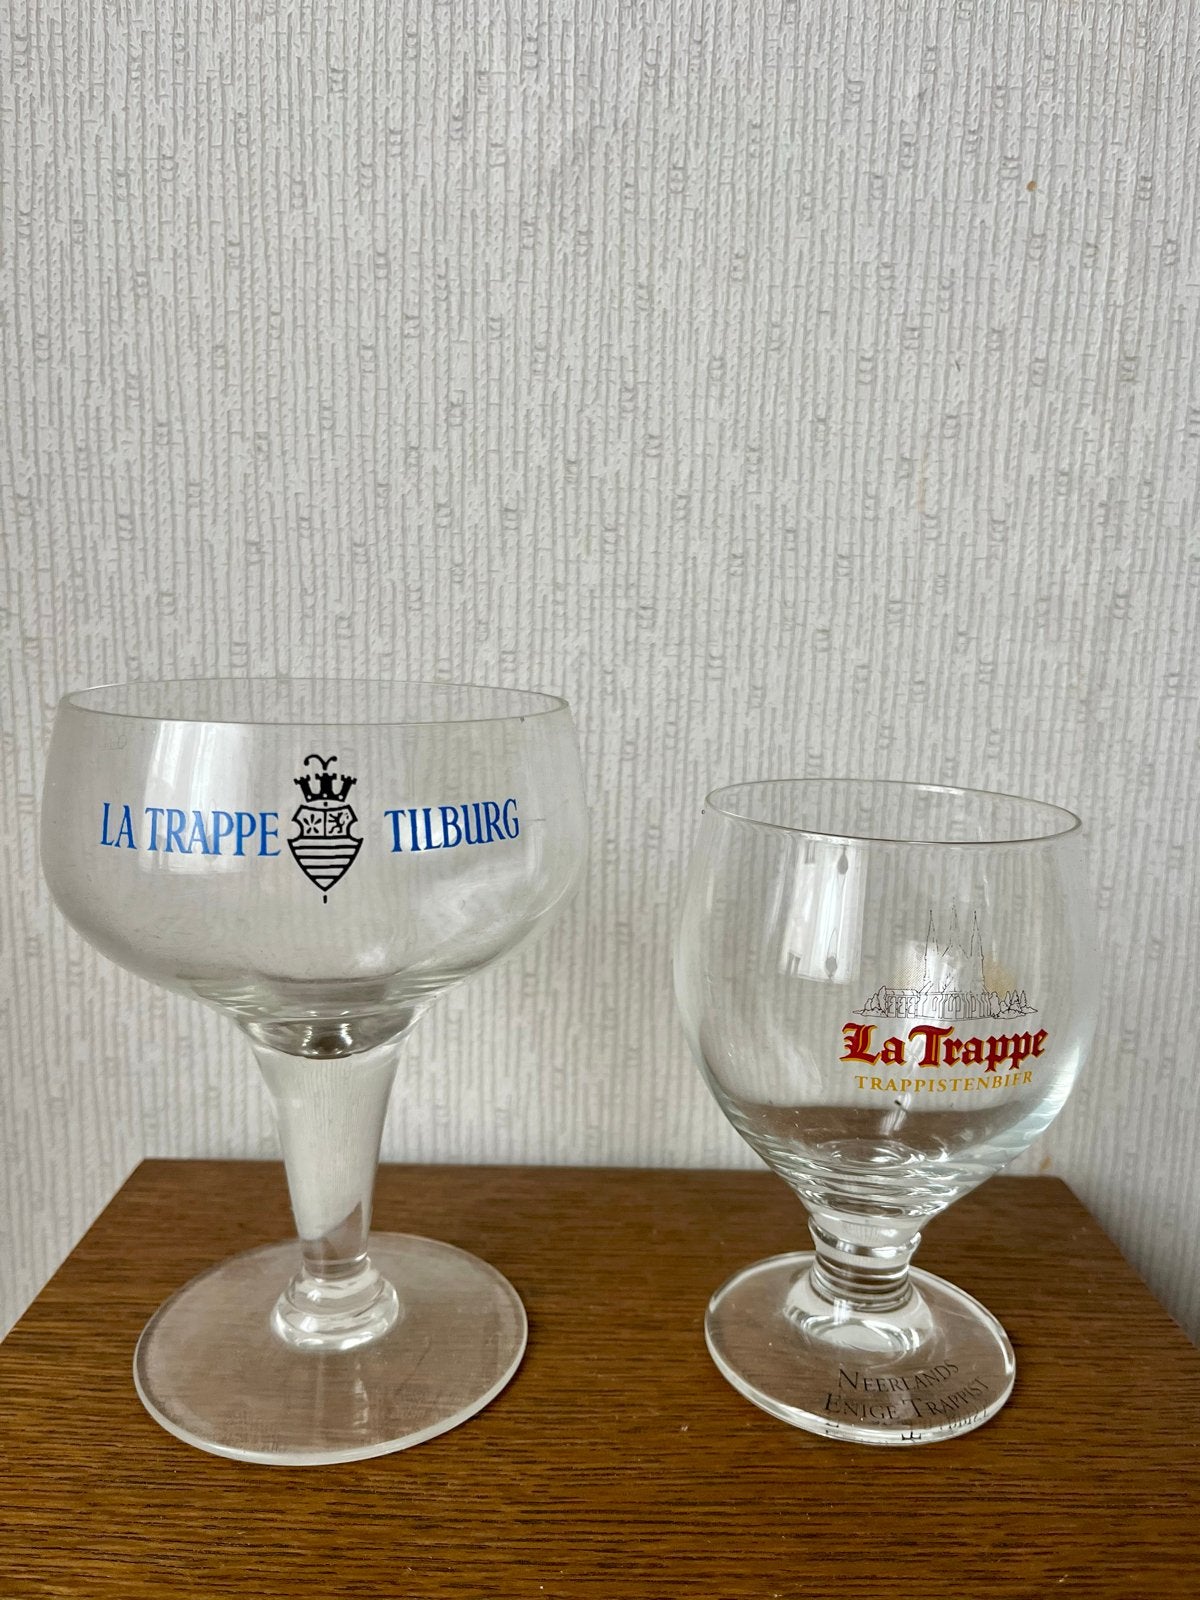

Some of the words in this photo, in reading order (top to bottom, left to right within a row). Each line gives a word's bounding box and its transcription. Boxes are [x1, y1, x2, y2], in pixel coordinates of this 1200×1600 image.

[101, 803, 138, 849] LA
[145, 807, 281, 857] TRAPPE
[384, 799, 519, 852] TILBURG
[839, 1022, 906, 1065] La
[908, 1024, 1049, 1073] Trappe
[854, 1071, 1033, 1093] TRAPPISTENBIER
